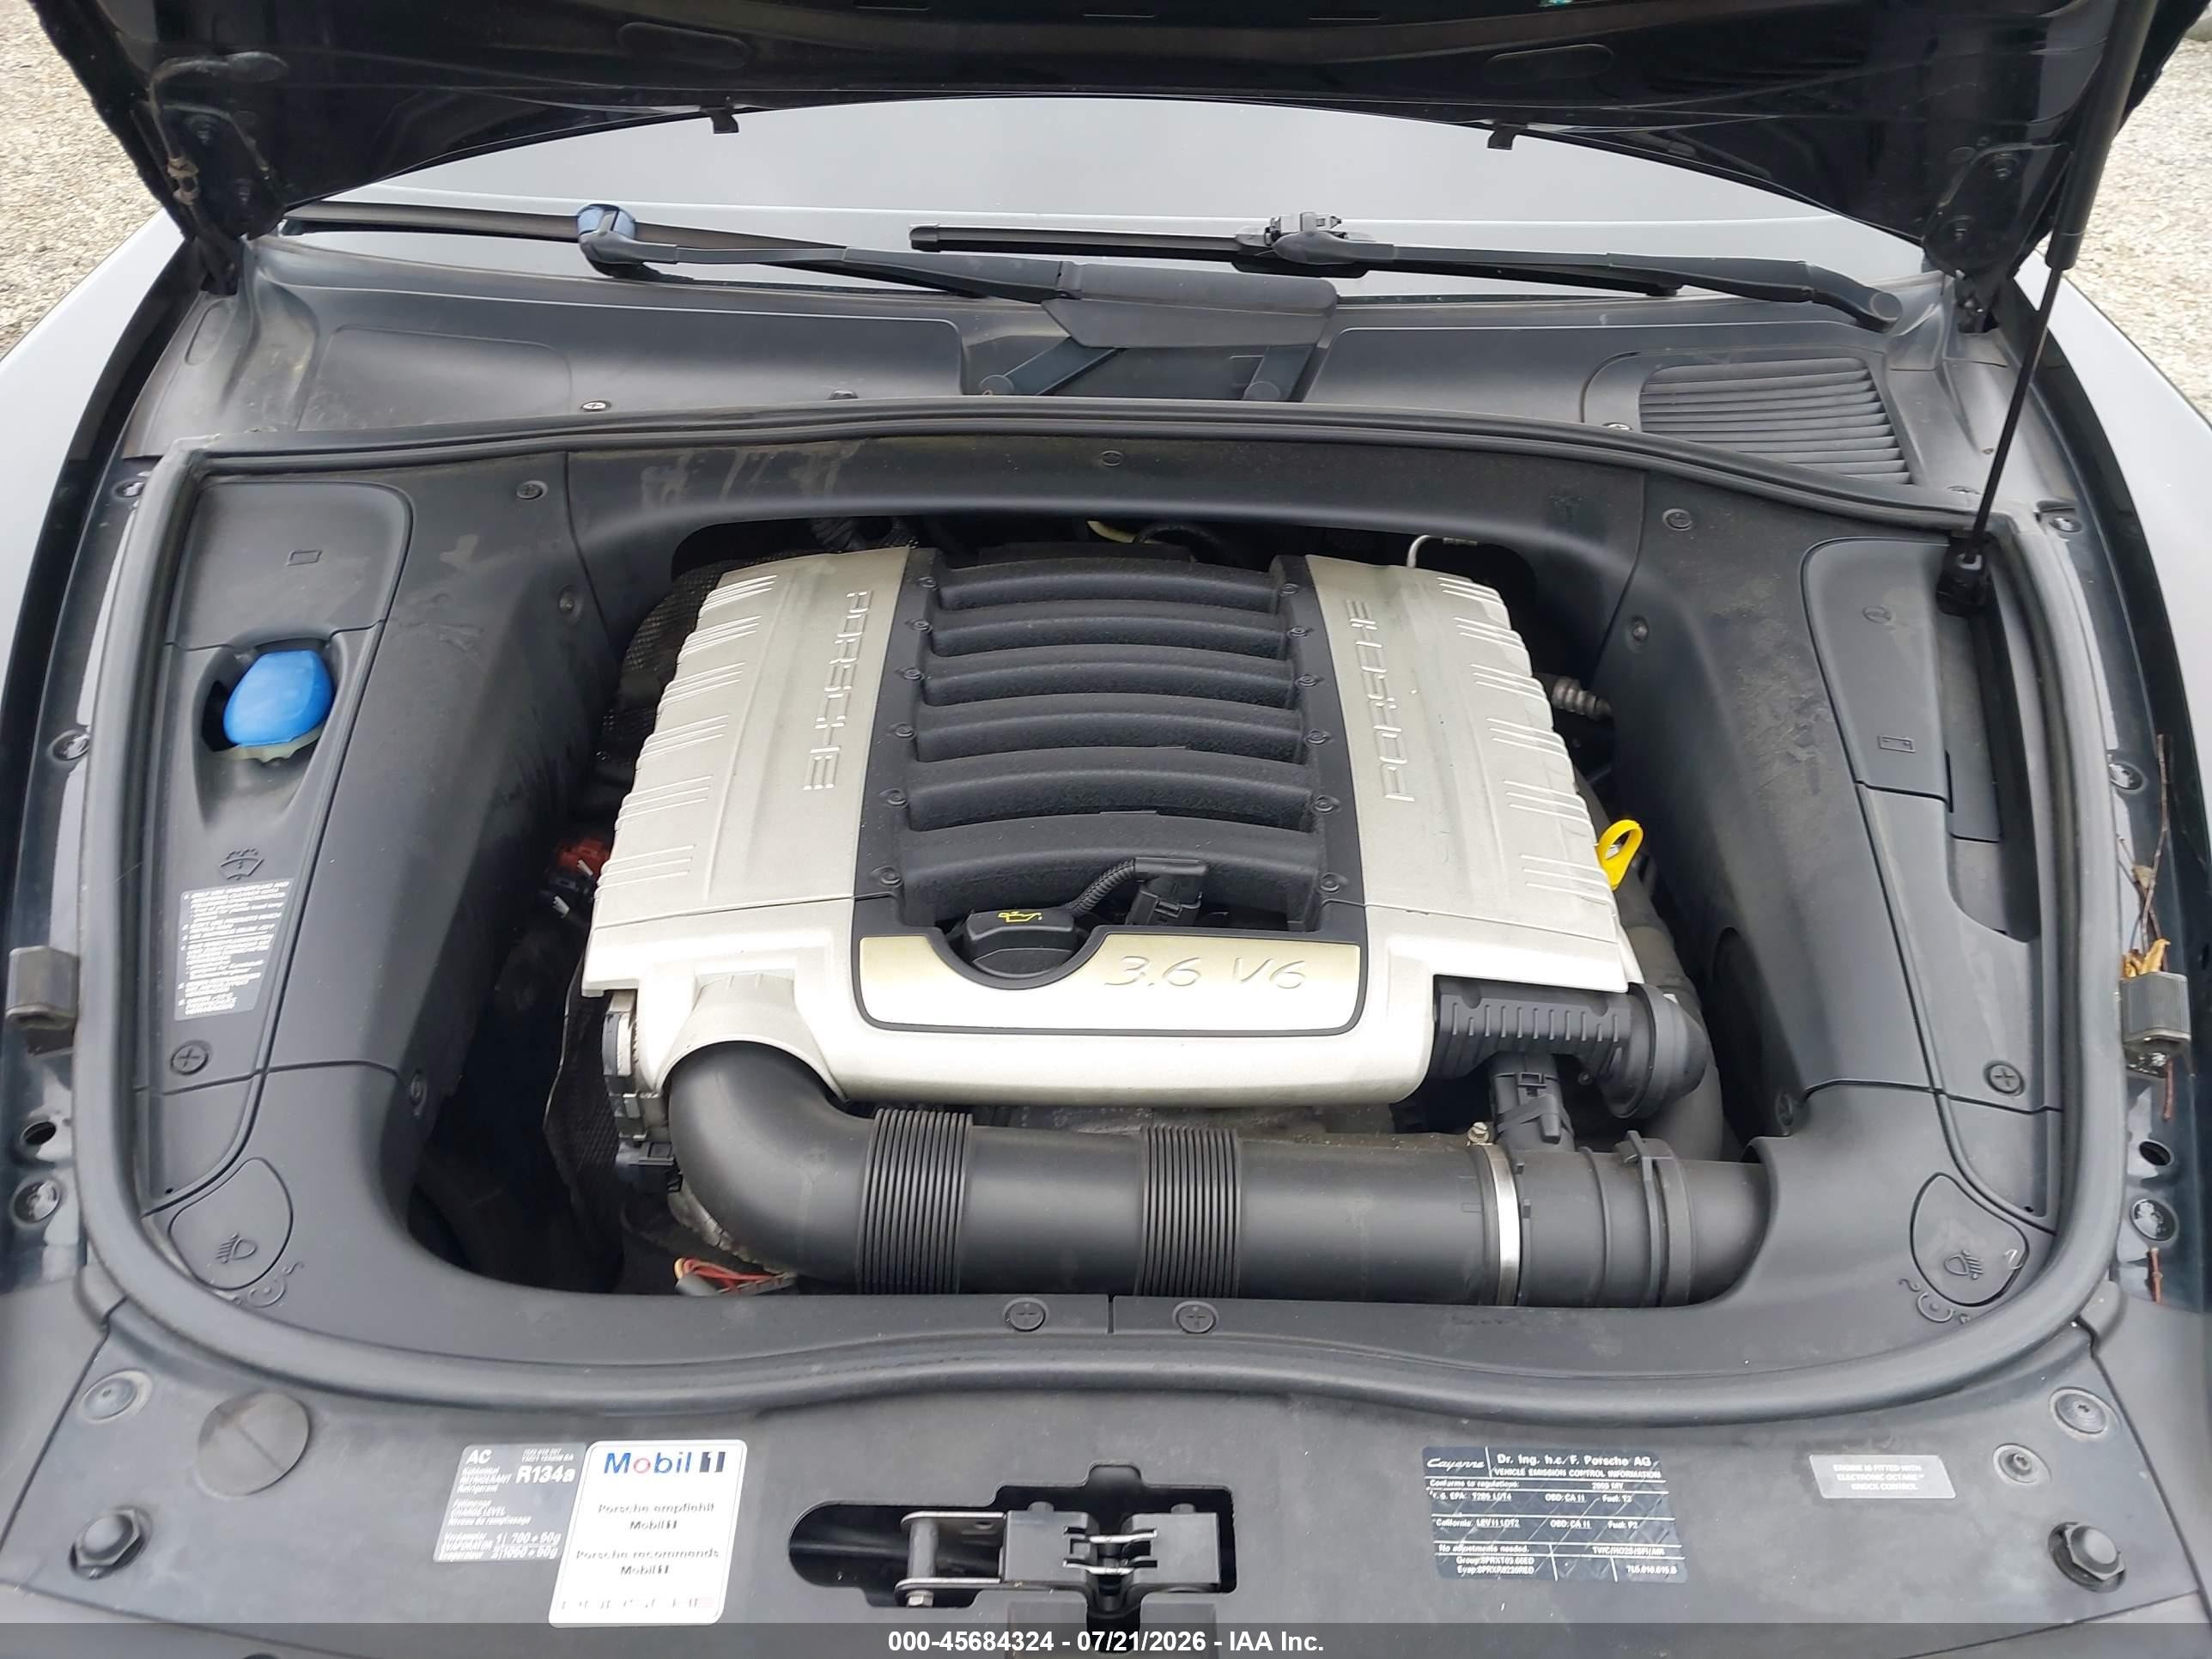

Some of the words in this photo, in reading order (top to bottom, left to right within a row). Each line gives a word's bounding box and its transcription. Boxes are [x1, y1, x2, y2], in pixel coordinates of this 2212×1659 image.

[803, 589, 873, 791] PORSCHE
[1344, 599, 1415, 802] PORSCHE
[1104, 954, 1201, 987] 3.6
[1231, 957, 1305, 989] V6
[466, 1449, 492, 1464] AC
[604, 1451, 692, 1474] Mobil
[1497, 1453, 1513, 1464] Dr.
[1517, 1454, 1540, 1467] Ing.
[1583, 1455, 1629, 1467] Porsche
[1633, 1456, 1651, 1467] AG
[1427, 1458, 1485, 1472] Cayenne
[1494, 1468, 1526, 1476] VEHICLE
[1528, 1468, 1567, 1477] EMISSION
[515, 1465, 575, 1484] R134a
[629, 1520, 665, 1530] Mobil
[620, 1565, 656, 1575] Mobil
